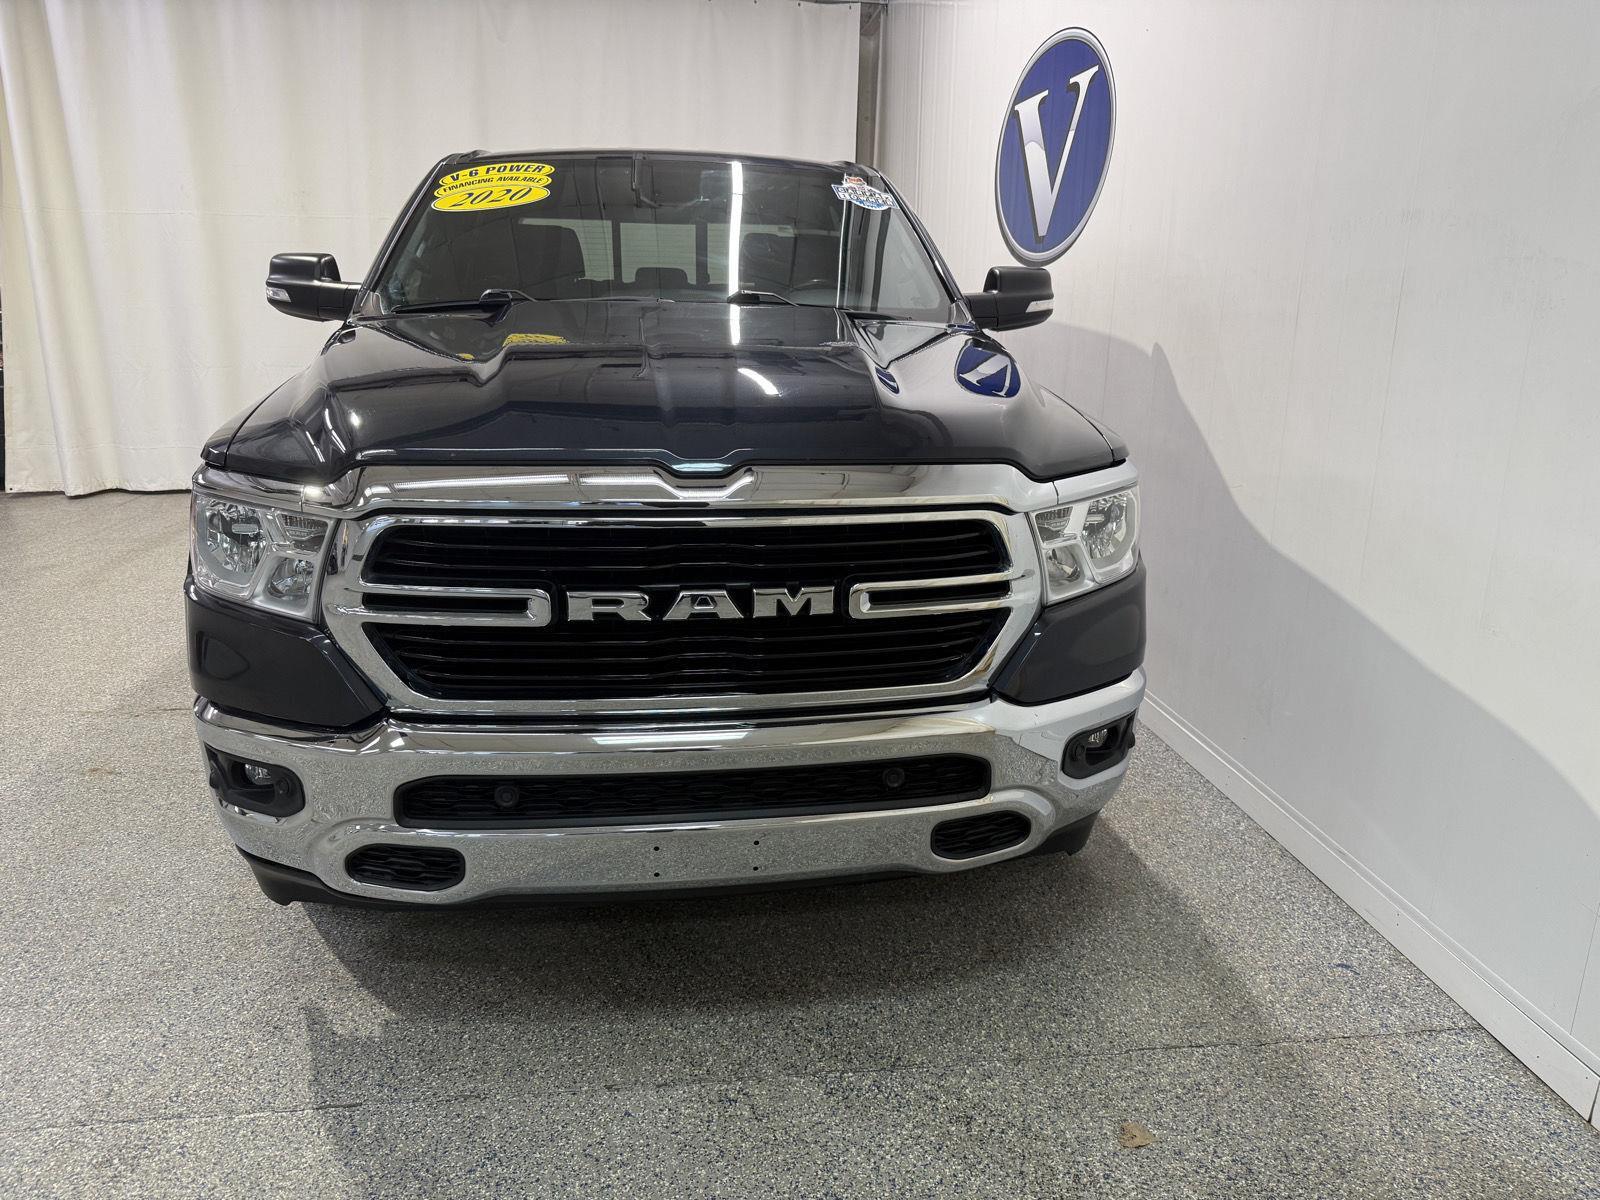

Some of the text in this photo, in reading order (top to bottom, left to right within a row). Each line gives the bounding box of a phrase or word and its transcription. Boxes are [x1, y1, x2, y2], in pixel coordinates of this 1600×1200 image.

[1014, 65, 1099, 237] V
[443, 175, 545, 192] FINANCING AVAILABLE
[450, 164, 546, 182] V-6 POWER
[449, 187, 533, 208] 2020
[566, 586, 835, 622] RAM
